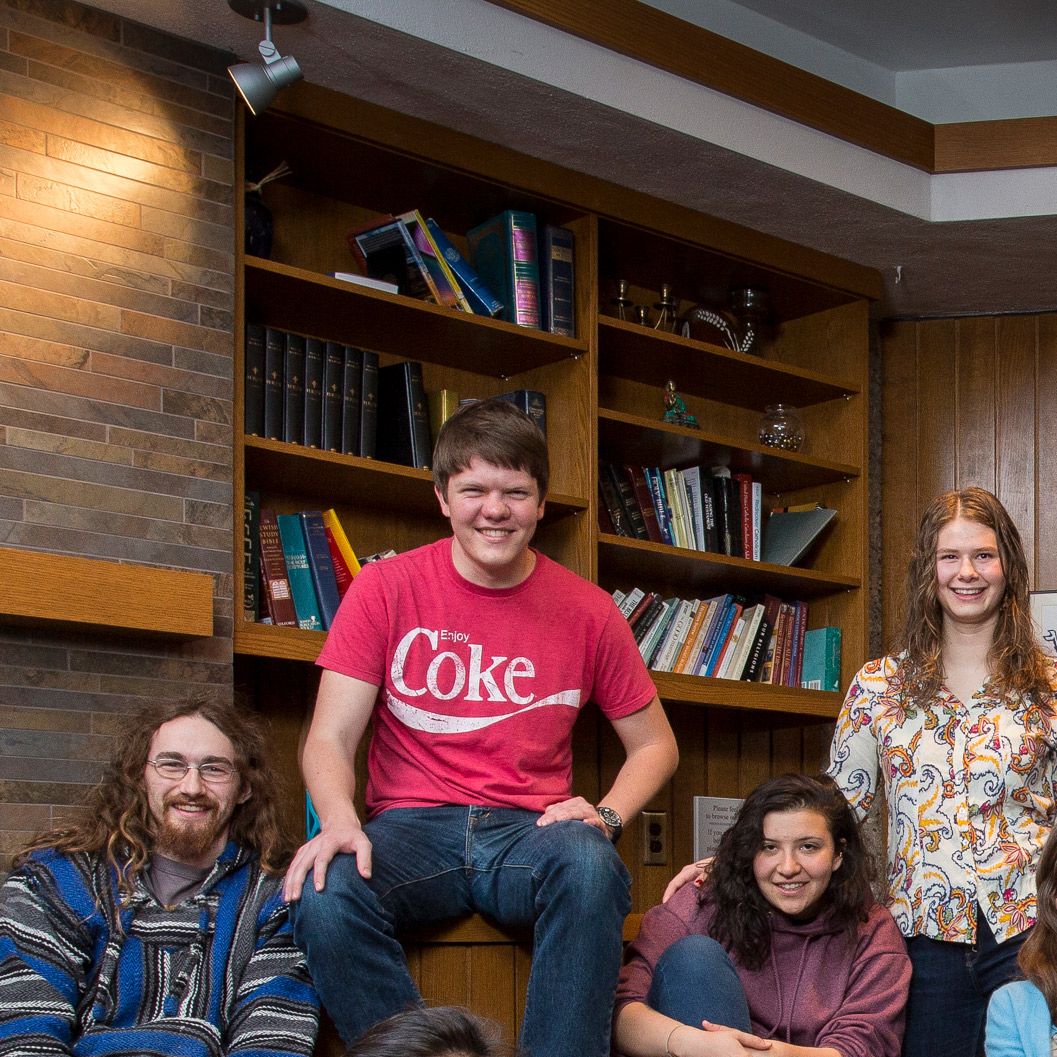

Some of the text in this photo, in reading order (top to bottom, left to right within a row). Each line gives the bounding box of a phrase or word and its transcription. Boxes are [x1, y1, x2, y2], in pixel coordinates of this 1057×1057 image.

[441, 630, 470, 643] Enjoy
[391, 627, 535, 705] Coke
[748, 638, 763, 673] RELIGIONS
